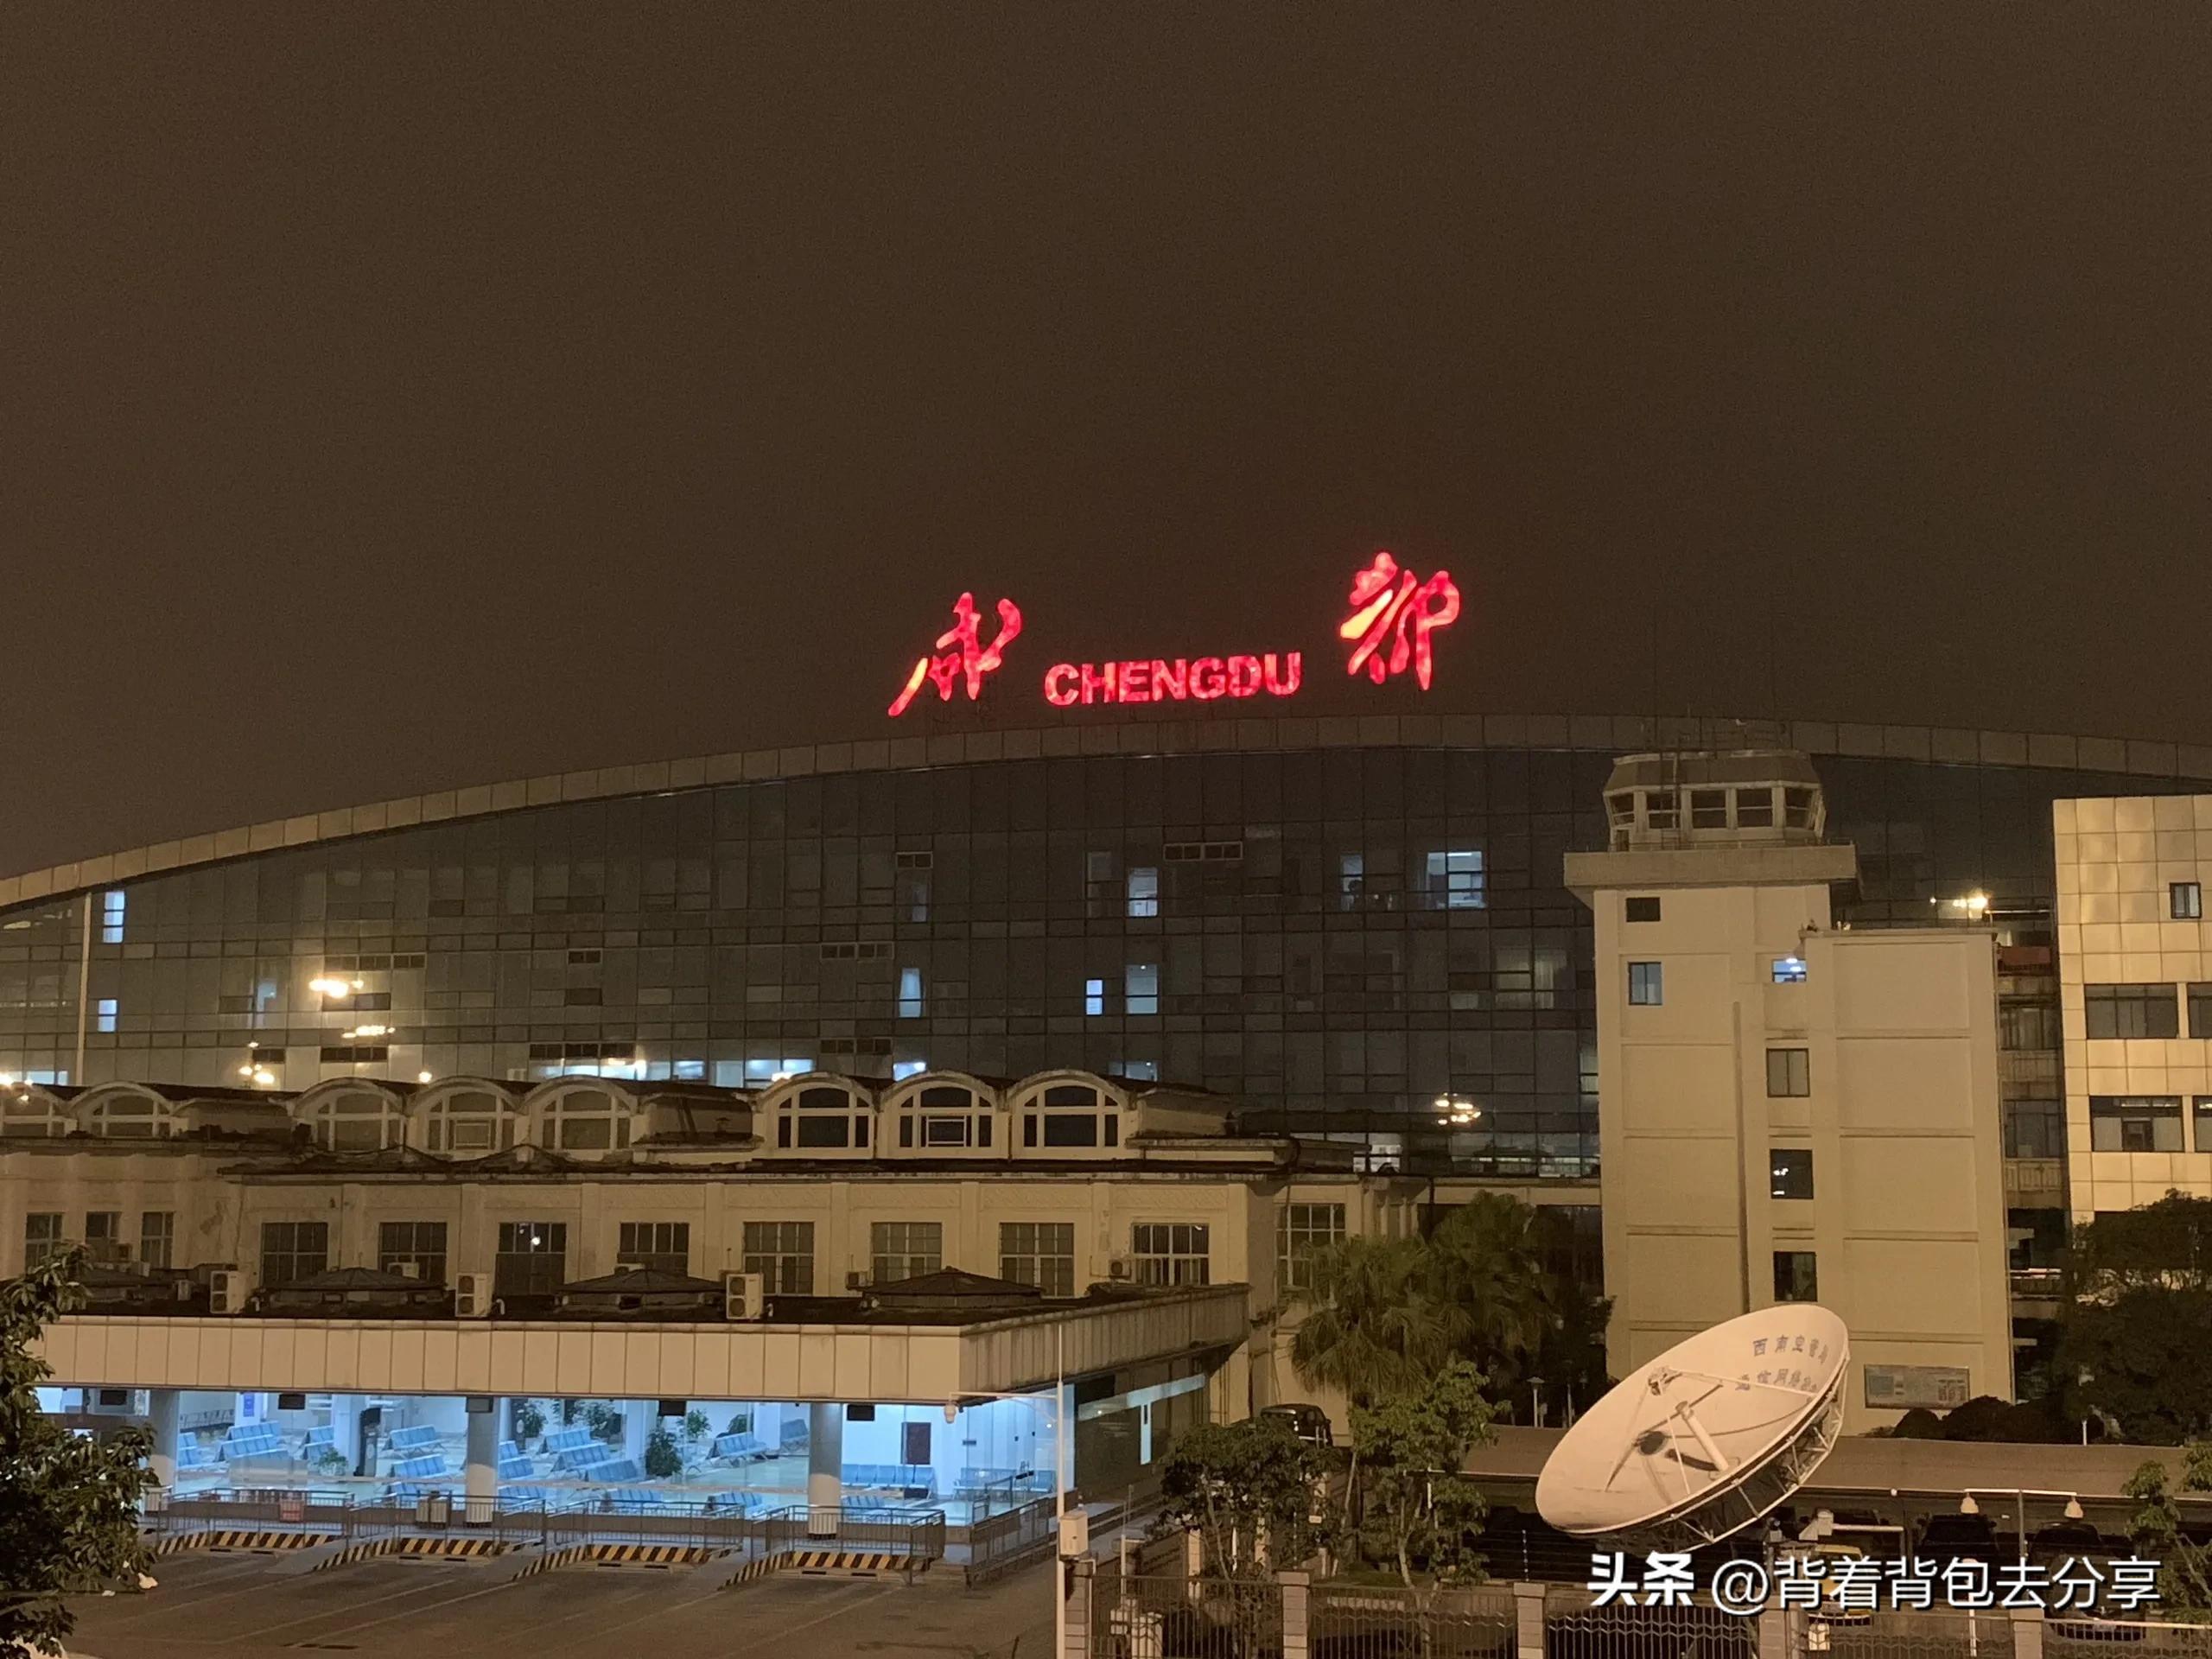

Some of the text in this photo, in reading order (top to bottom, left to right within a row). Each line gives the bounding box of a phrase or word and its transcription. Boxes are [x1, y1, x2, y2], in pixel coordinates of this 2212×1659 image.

[888, 594, 1023, 717] 成
[1043, 652, 1303, 708] CHENGDU
[1338, 552, 1463, 690] 都
